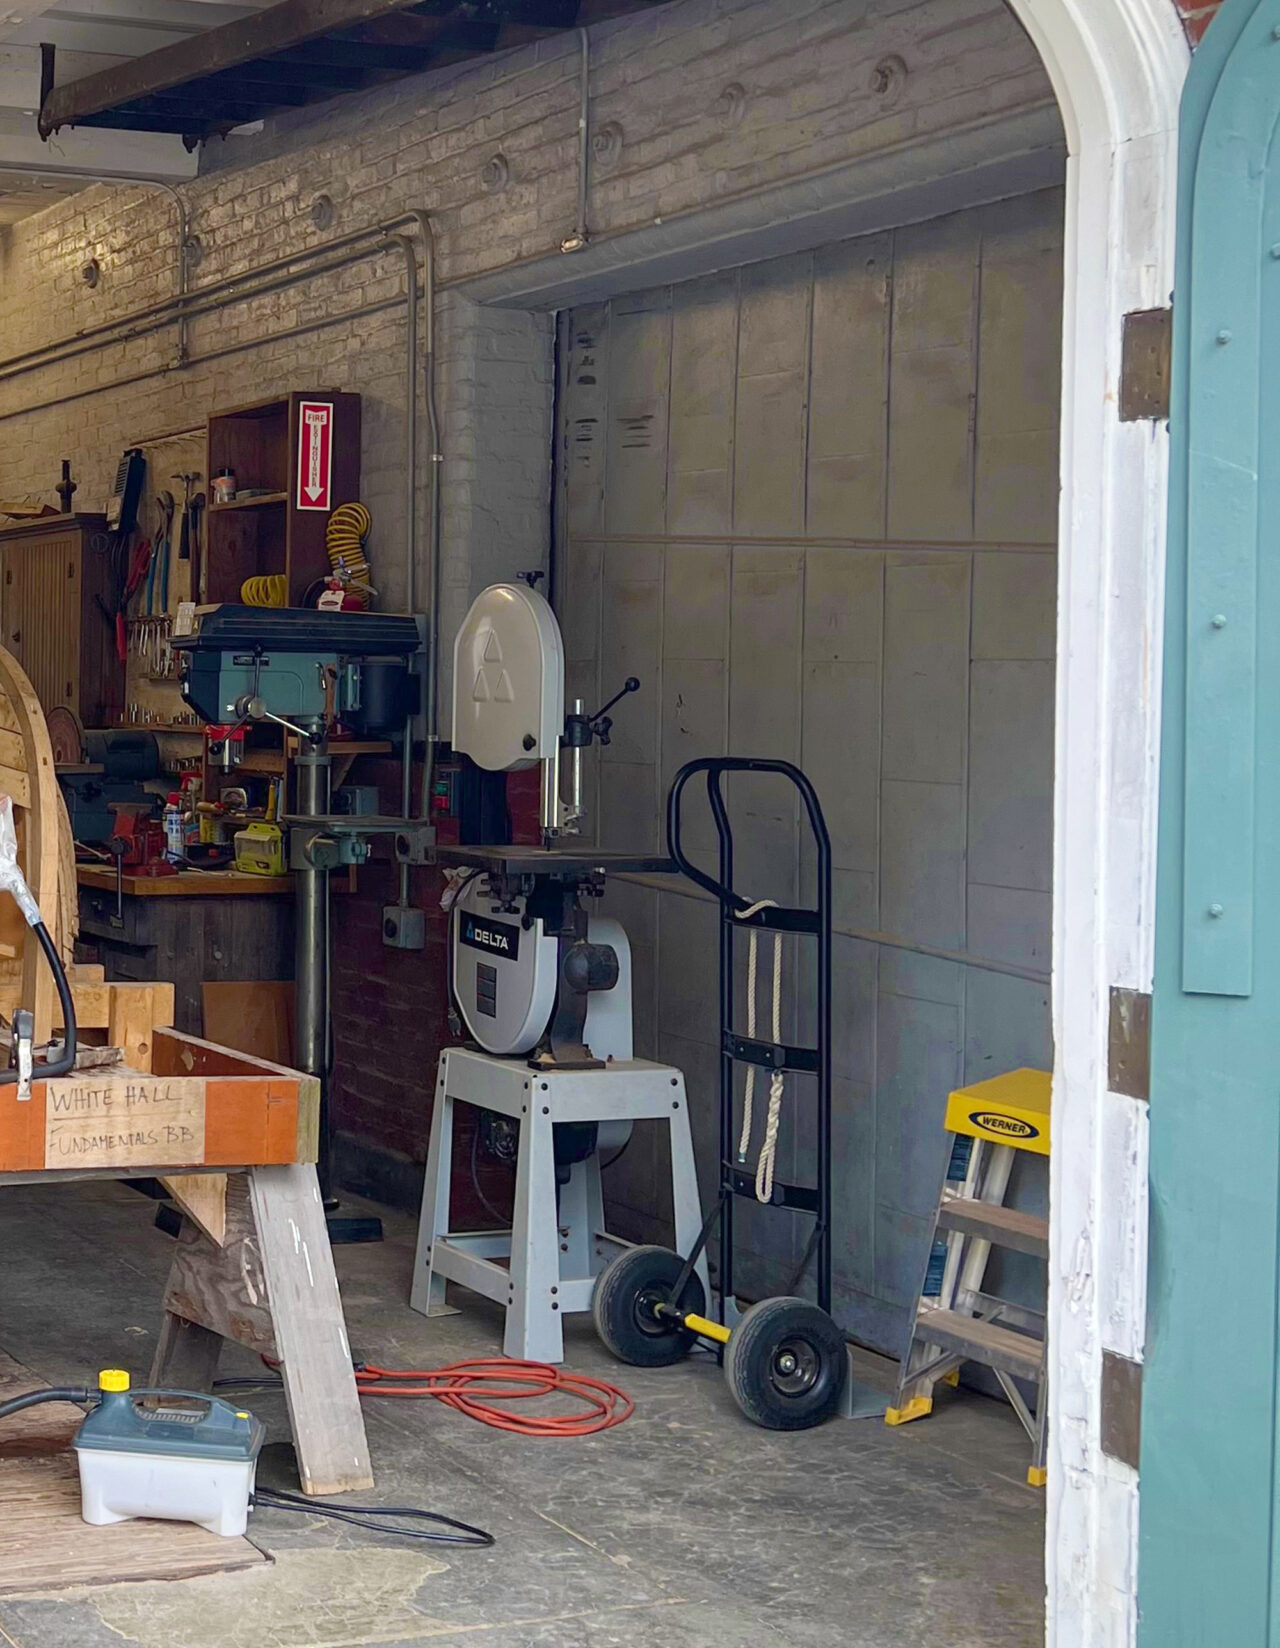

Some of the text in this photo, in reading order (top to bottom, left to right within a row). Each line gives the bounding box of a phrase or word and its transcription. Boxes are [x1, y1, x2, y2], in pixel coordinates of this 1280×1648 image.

[307, 414, 325, 422] FIRE
[311, 425, 319, 488] EXTINGUISHER
[474, 927, 509, 950] DELTA
[49, 1084, 183, 1112] WHITE HALL
[982, 1116, 1027, 1134] WERNER
[49, 1126, 158, 1156] FUNDAMENTALS
